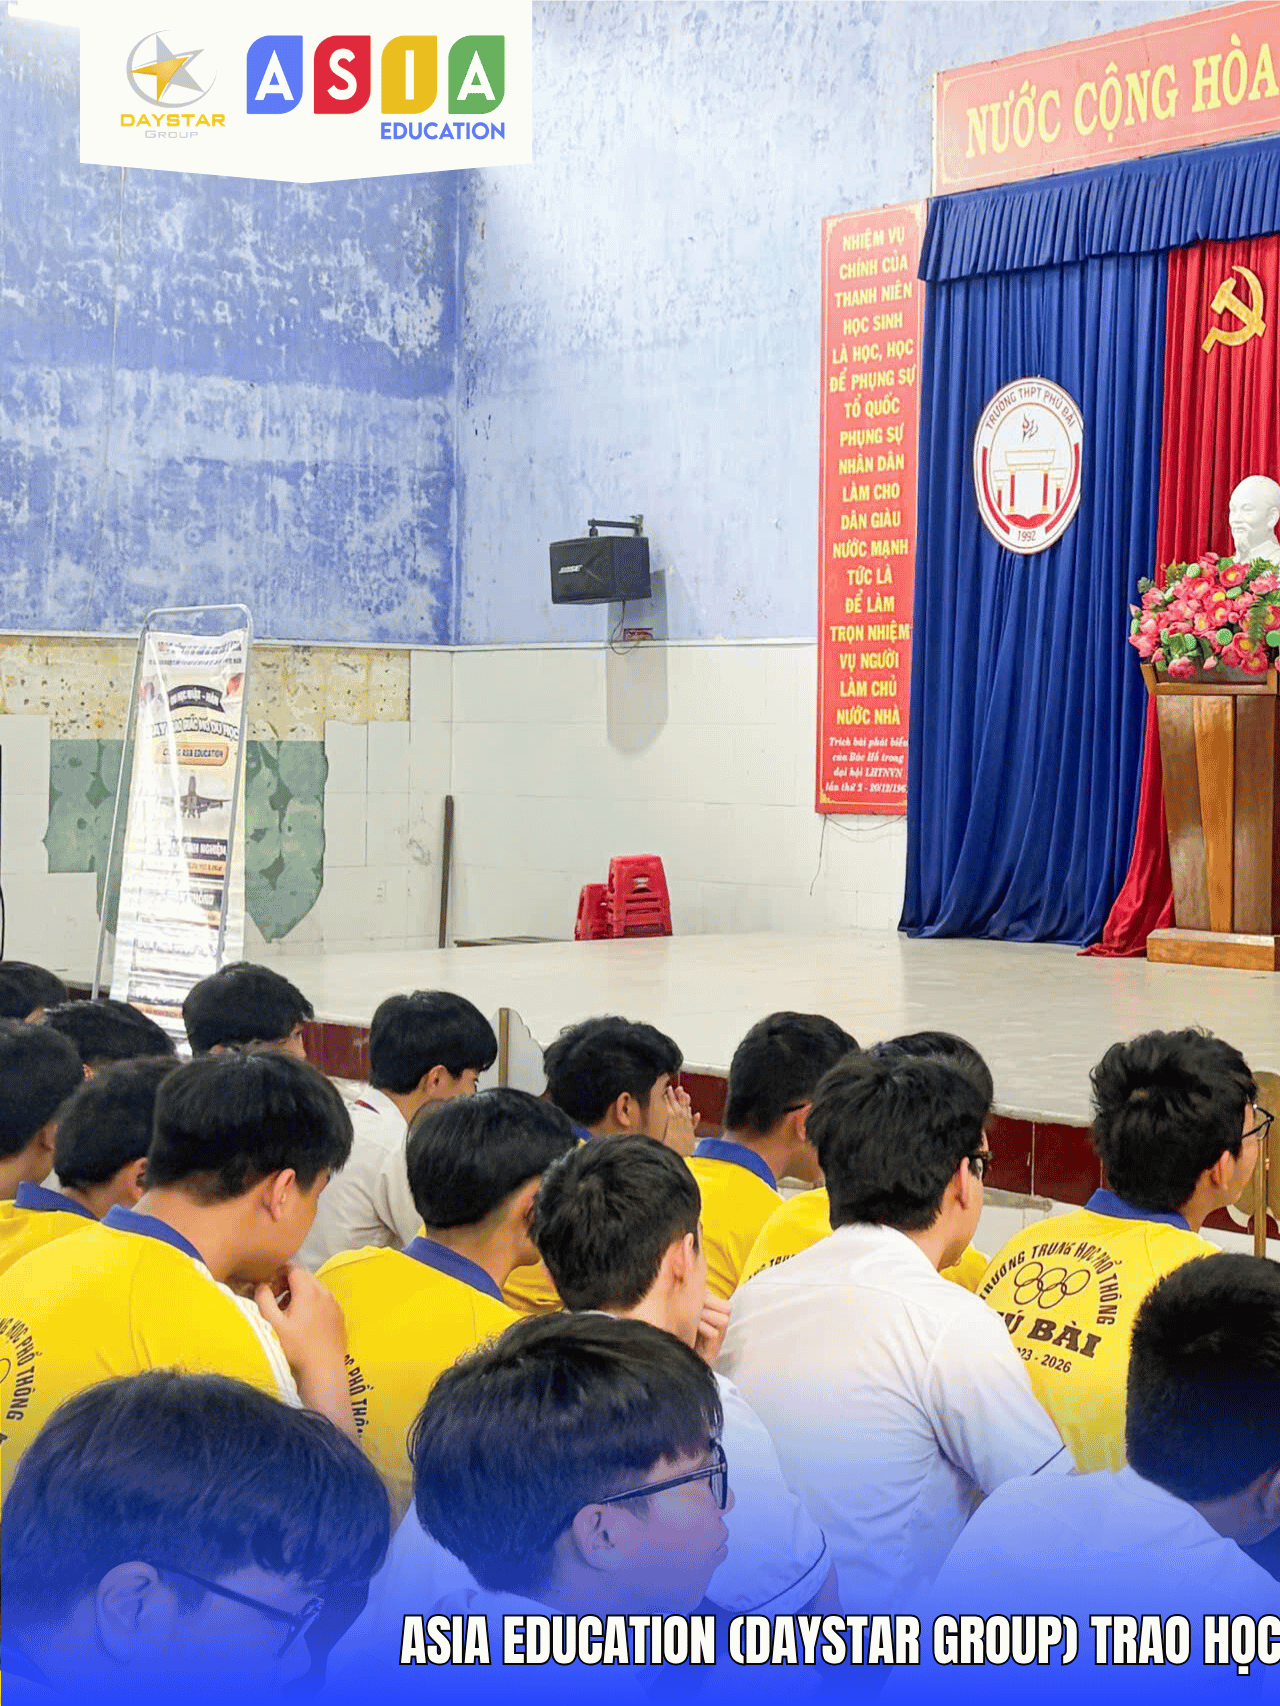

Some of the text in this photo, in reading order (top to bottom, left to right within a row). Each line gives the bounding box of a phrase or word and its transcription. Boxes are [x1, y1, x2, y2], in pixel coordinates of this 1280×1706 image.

[966, 80, 1060, 159] NƯỚC
[1074, 61, 1179, 142] CỘNG
[1192, 33, 1280, 113] HÒA
[842, 226, 905, 251] NHIỆM VỤ
[839, 249, 908, 280] CHÍNH CỦA
[834, 280, 913, 308] THANH NIÊN
[843, 312, 903, 338] HỌC SINH
[832, 343, 848, 364] LÀ
[887, 339, 914, 359] HỌC
[829, 363, 917, 393] ĐỂ PHỤNG SỰ
[844, 391, 900, 419] TỔ QUỐC
[1018, 387, 1042, 399] THPT
[840, 422, 904, 448] PHỤNG SỰ
[838, 451, 905, 475] NHÂN DÂN
[842, 481, 901, 503] LÀM CHO
[840, 507, 901, 530] DÂN GIÀU
[832, 537, 909, 559] NƯỚC MẠNH
[1017, 530, 1037, 543] 1992
[847, 562, 893, 586] TỨC LÀ
[845, 589, 895, 614] ĐỂ LÀM
[830, 619, 911, 645] TRỌN NHIỆM
[839, 647, 900, 672] VỤ NGƯỜI
[840, 675, 897, 698] LÀM CHỦ
[836, 704, 901, 726] NƯỚC NHÀ
[1096, 1273, 1123, 1325] THÔNG
[1027, 1318, 1102, 1359] BÀI
[1041, 1354, 1072, 1374] 2026
[6, 1365, 36, 1421] THÔNG
